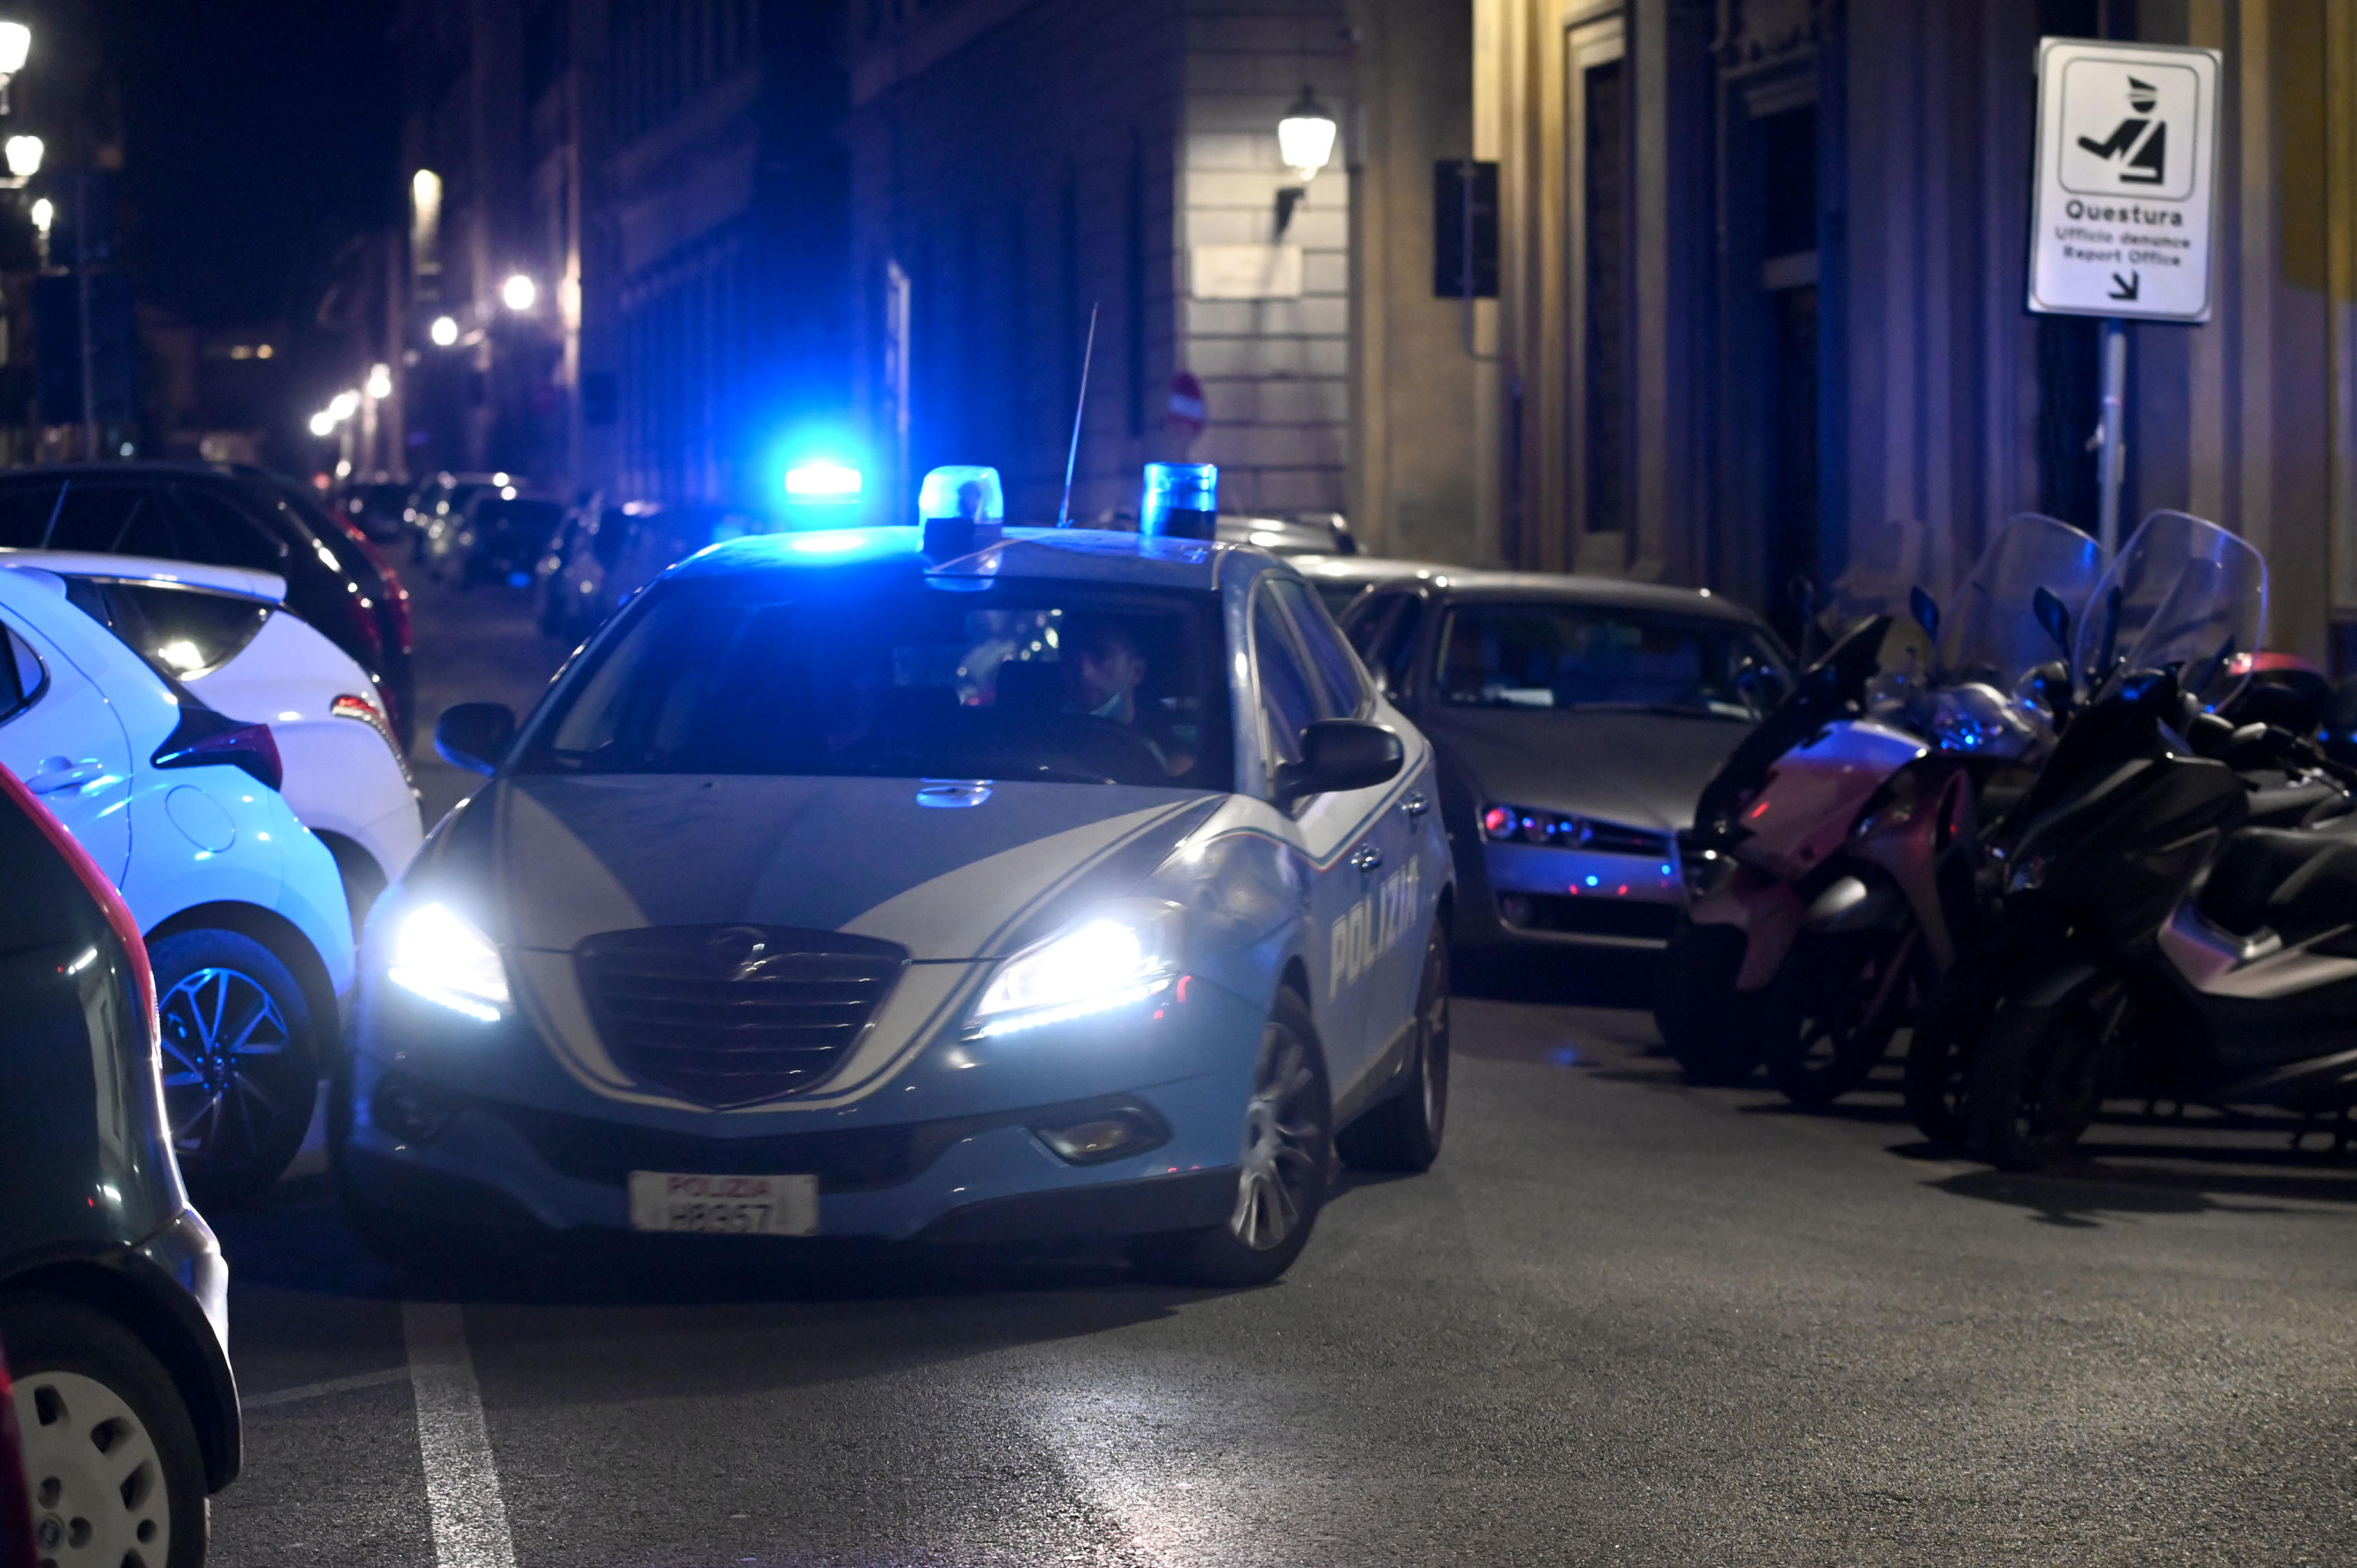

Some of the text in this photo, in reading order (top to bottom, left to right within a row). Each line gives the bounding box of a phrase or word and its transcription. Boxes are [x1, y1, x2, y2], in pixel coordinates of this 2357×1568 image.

[2065, 199, 2184, 226] Questura
[2055, 226, 2113, 242] Ufficio
[2064, 245, 2181, 265] Report Office
[1330, 854, 1419, 1003] POLIZIA
[668, 1174, 770, 1197] POLIZIA
